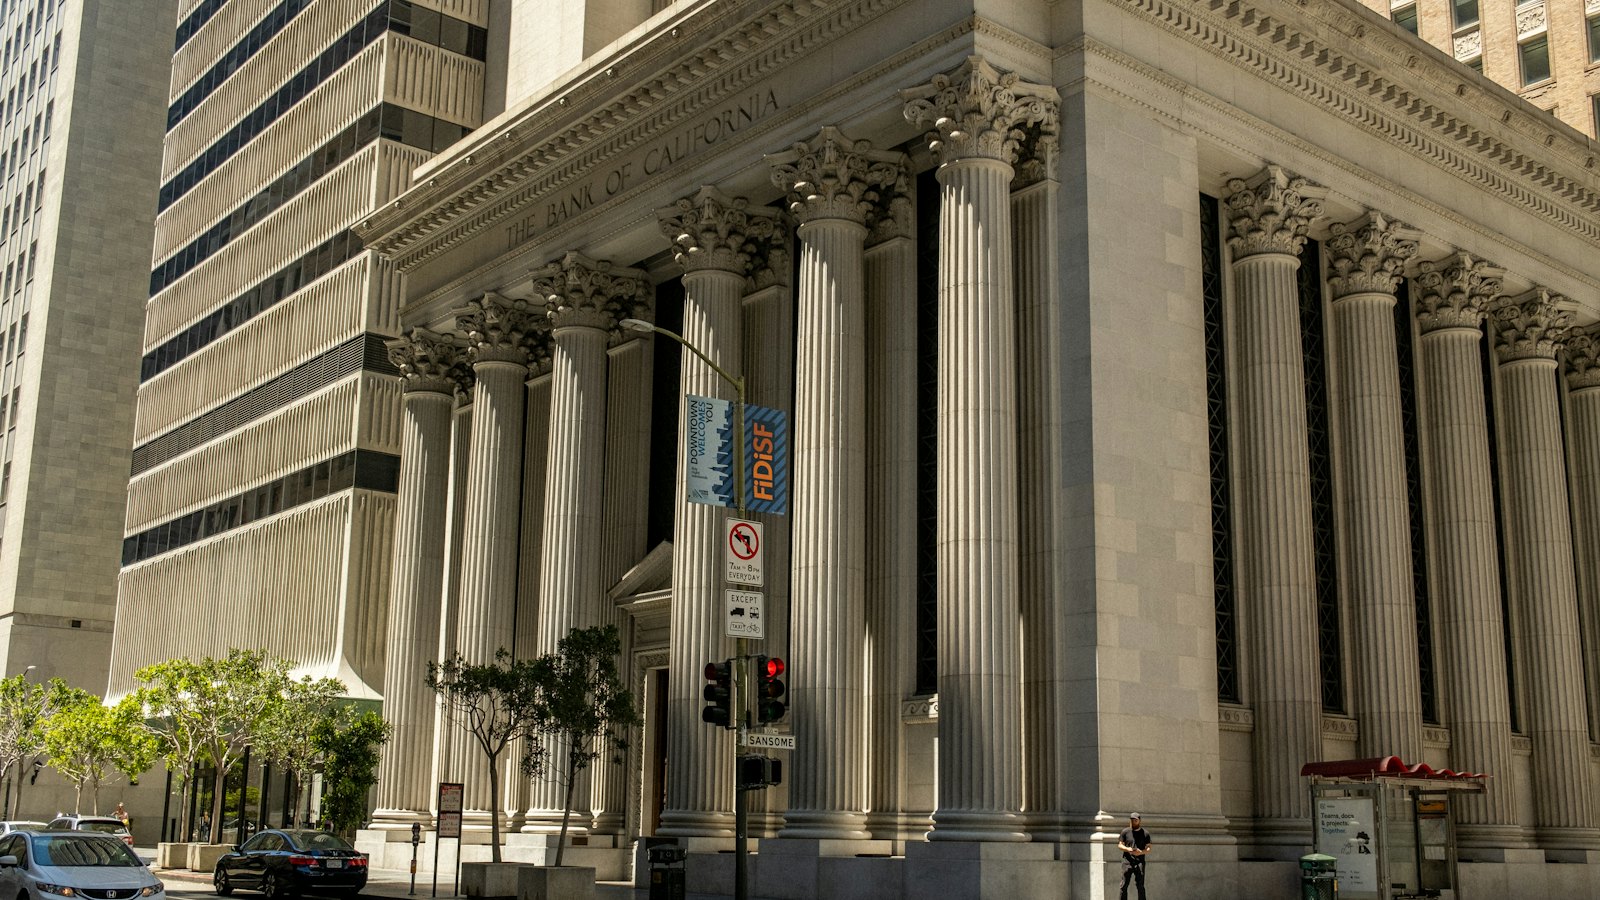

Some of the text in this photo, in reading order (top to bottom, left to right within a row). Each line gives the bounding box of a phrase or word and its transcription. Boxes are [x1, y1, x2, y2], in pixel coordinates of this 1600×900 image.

[505, 89, 779, 250] THE BANK OF CALIFORNIA
[690, 400, 698, 465] DOWNTOWN
[698, 401, 706, 456] WELCOMES
[753, 422, 774, 501] FiDiSF
[728, 571, 761, 581] EVERYDAY
[731, 594, 757, 604] EXCEPT
[749, 736, 794, 748] SANSOME
[1320, 812, 1341, 820] Teams,
[1326, 820, 1350, 828] projects.
